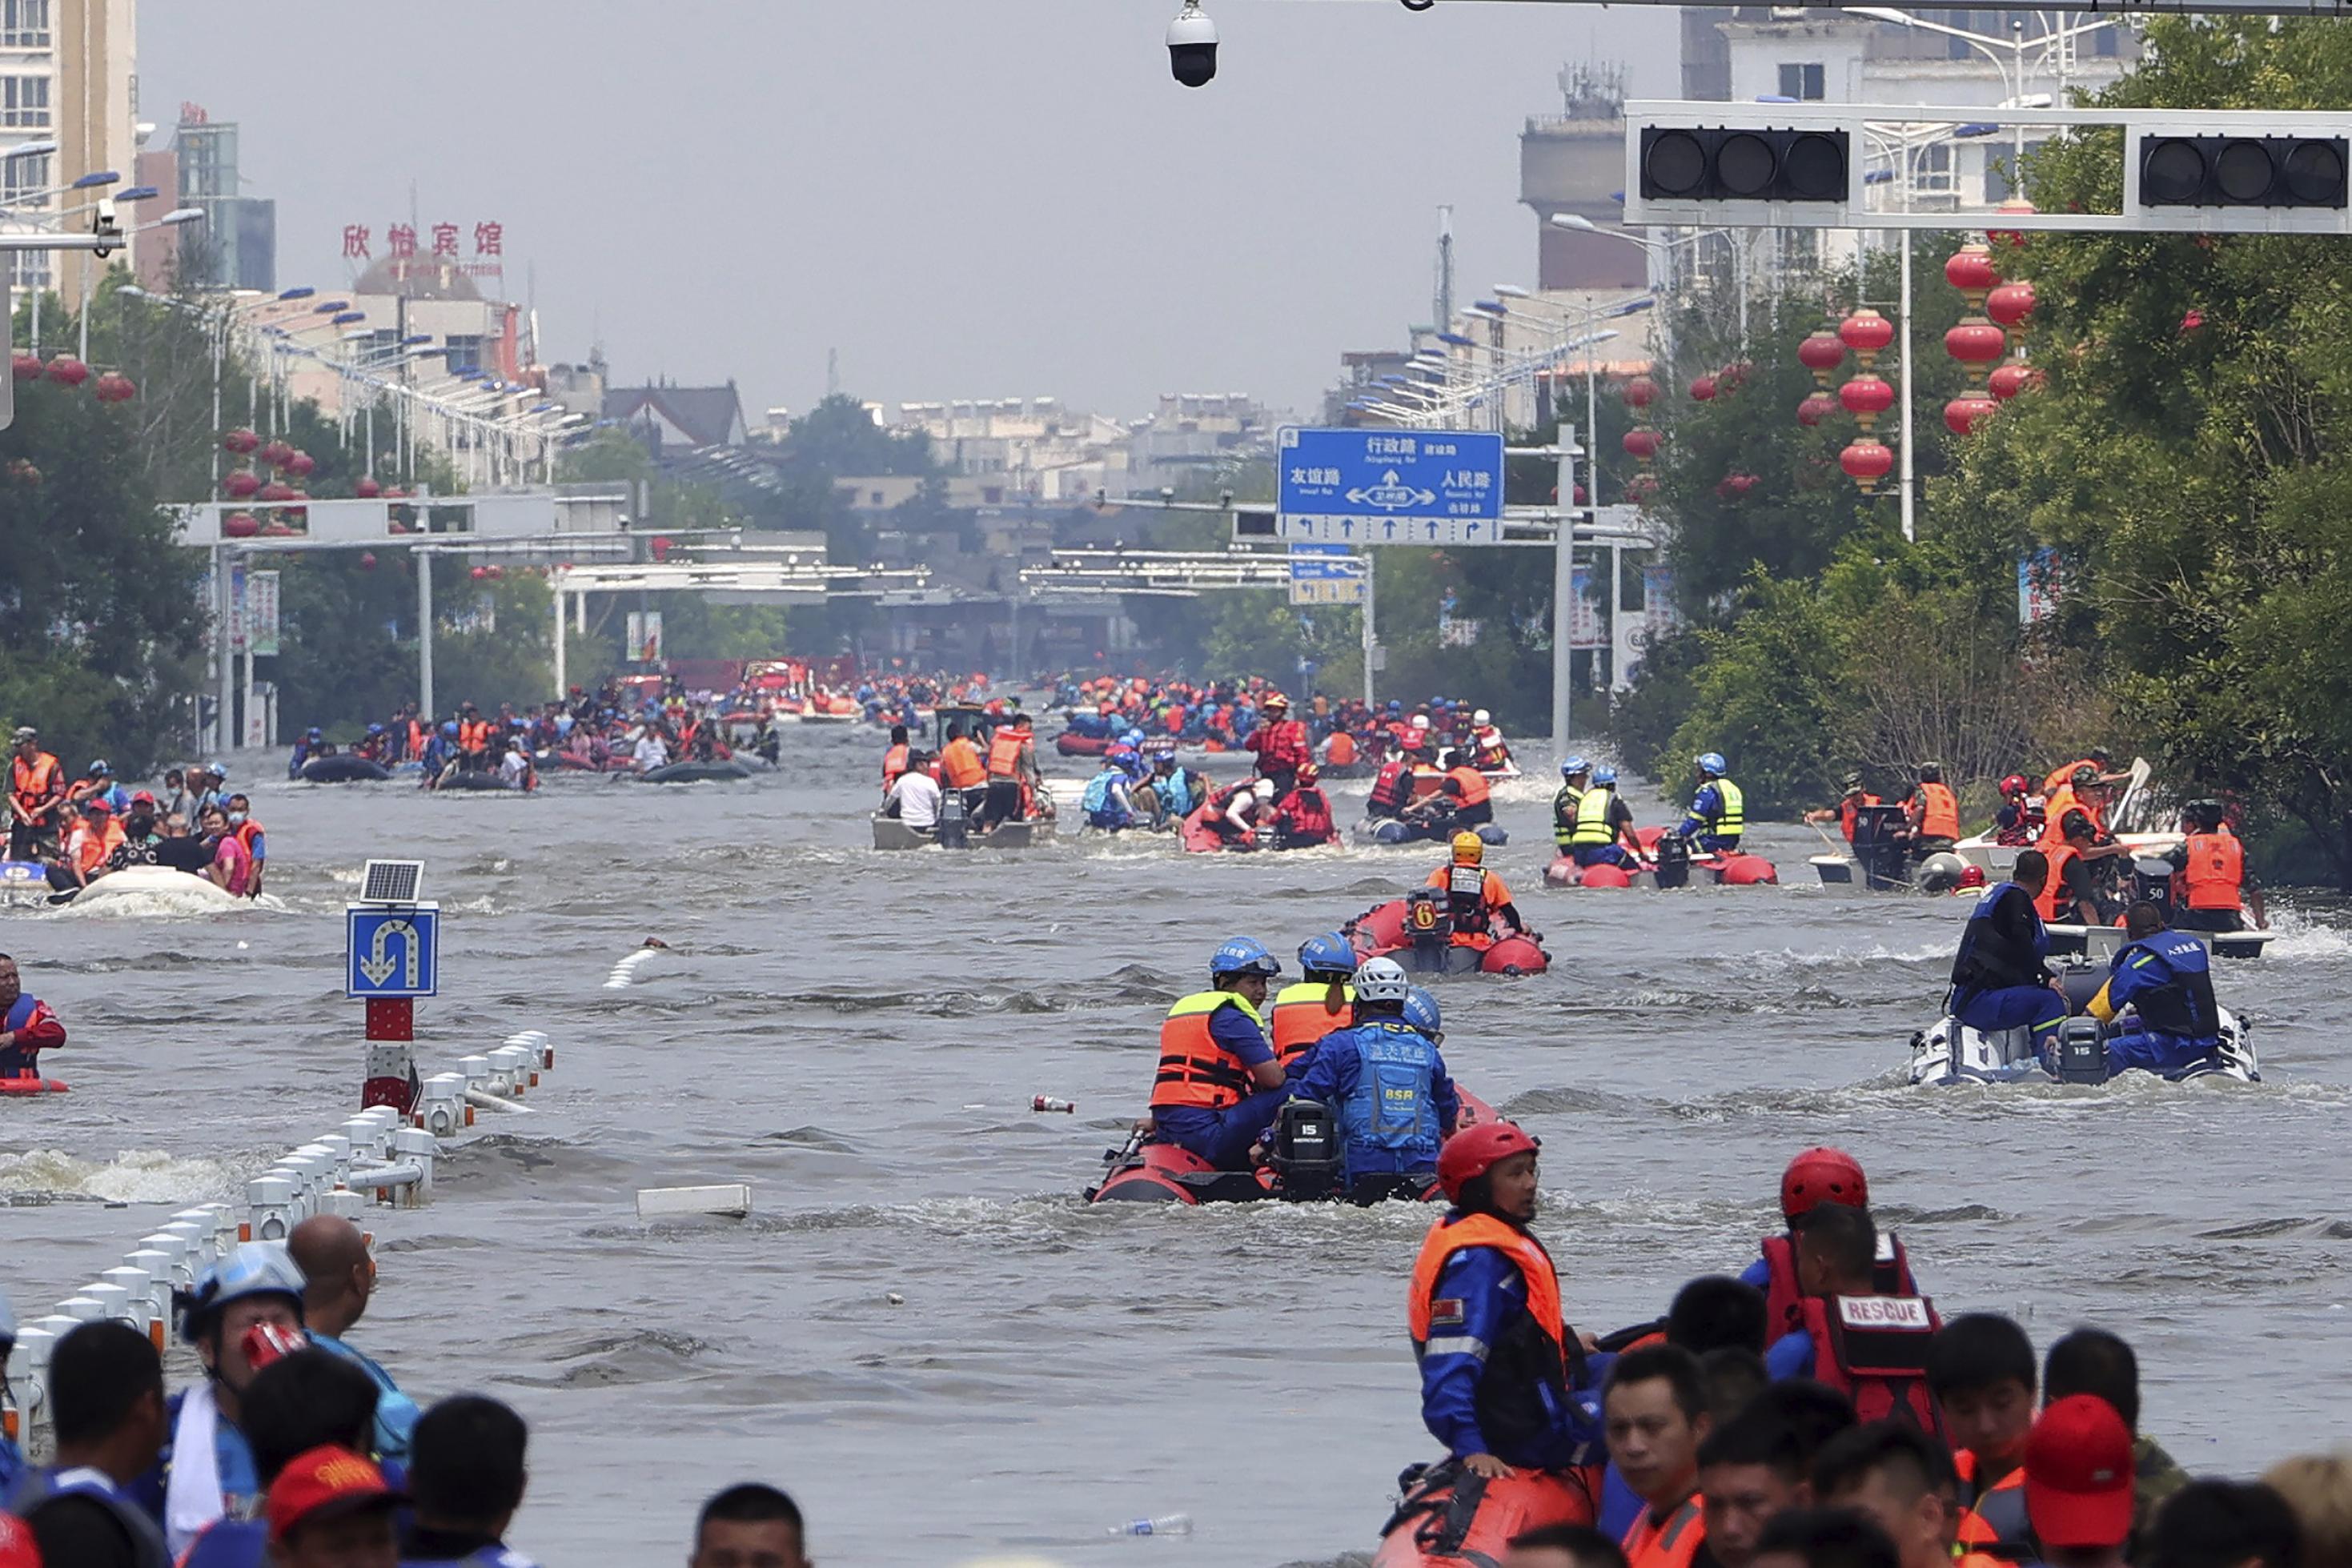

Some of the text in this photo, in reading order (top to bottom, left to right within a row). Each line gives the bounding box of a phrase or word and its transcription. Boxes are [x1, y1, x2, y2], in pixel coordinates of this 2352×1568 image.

[343, 220, 503, 259] 欣怡宾馆
[1366, 436, 1417, 455] 行政路
[1290, 467, 1339, 486] 友谊路
[1440, 469, 1492, 490] 人民路
[2149, 888, 2164, 900] 50
[1416, 904, 1433, 926] 6
[2074, 1046, 2090, 1056] 15
[1386, 1089, 1413, 1101] BSR
[1302, 1124, 1317, 1135] 15
[1847, 1301, 1919, 1321] RESCUE
